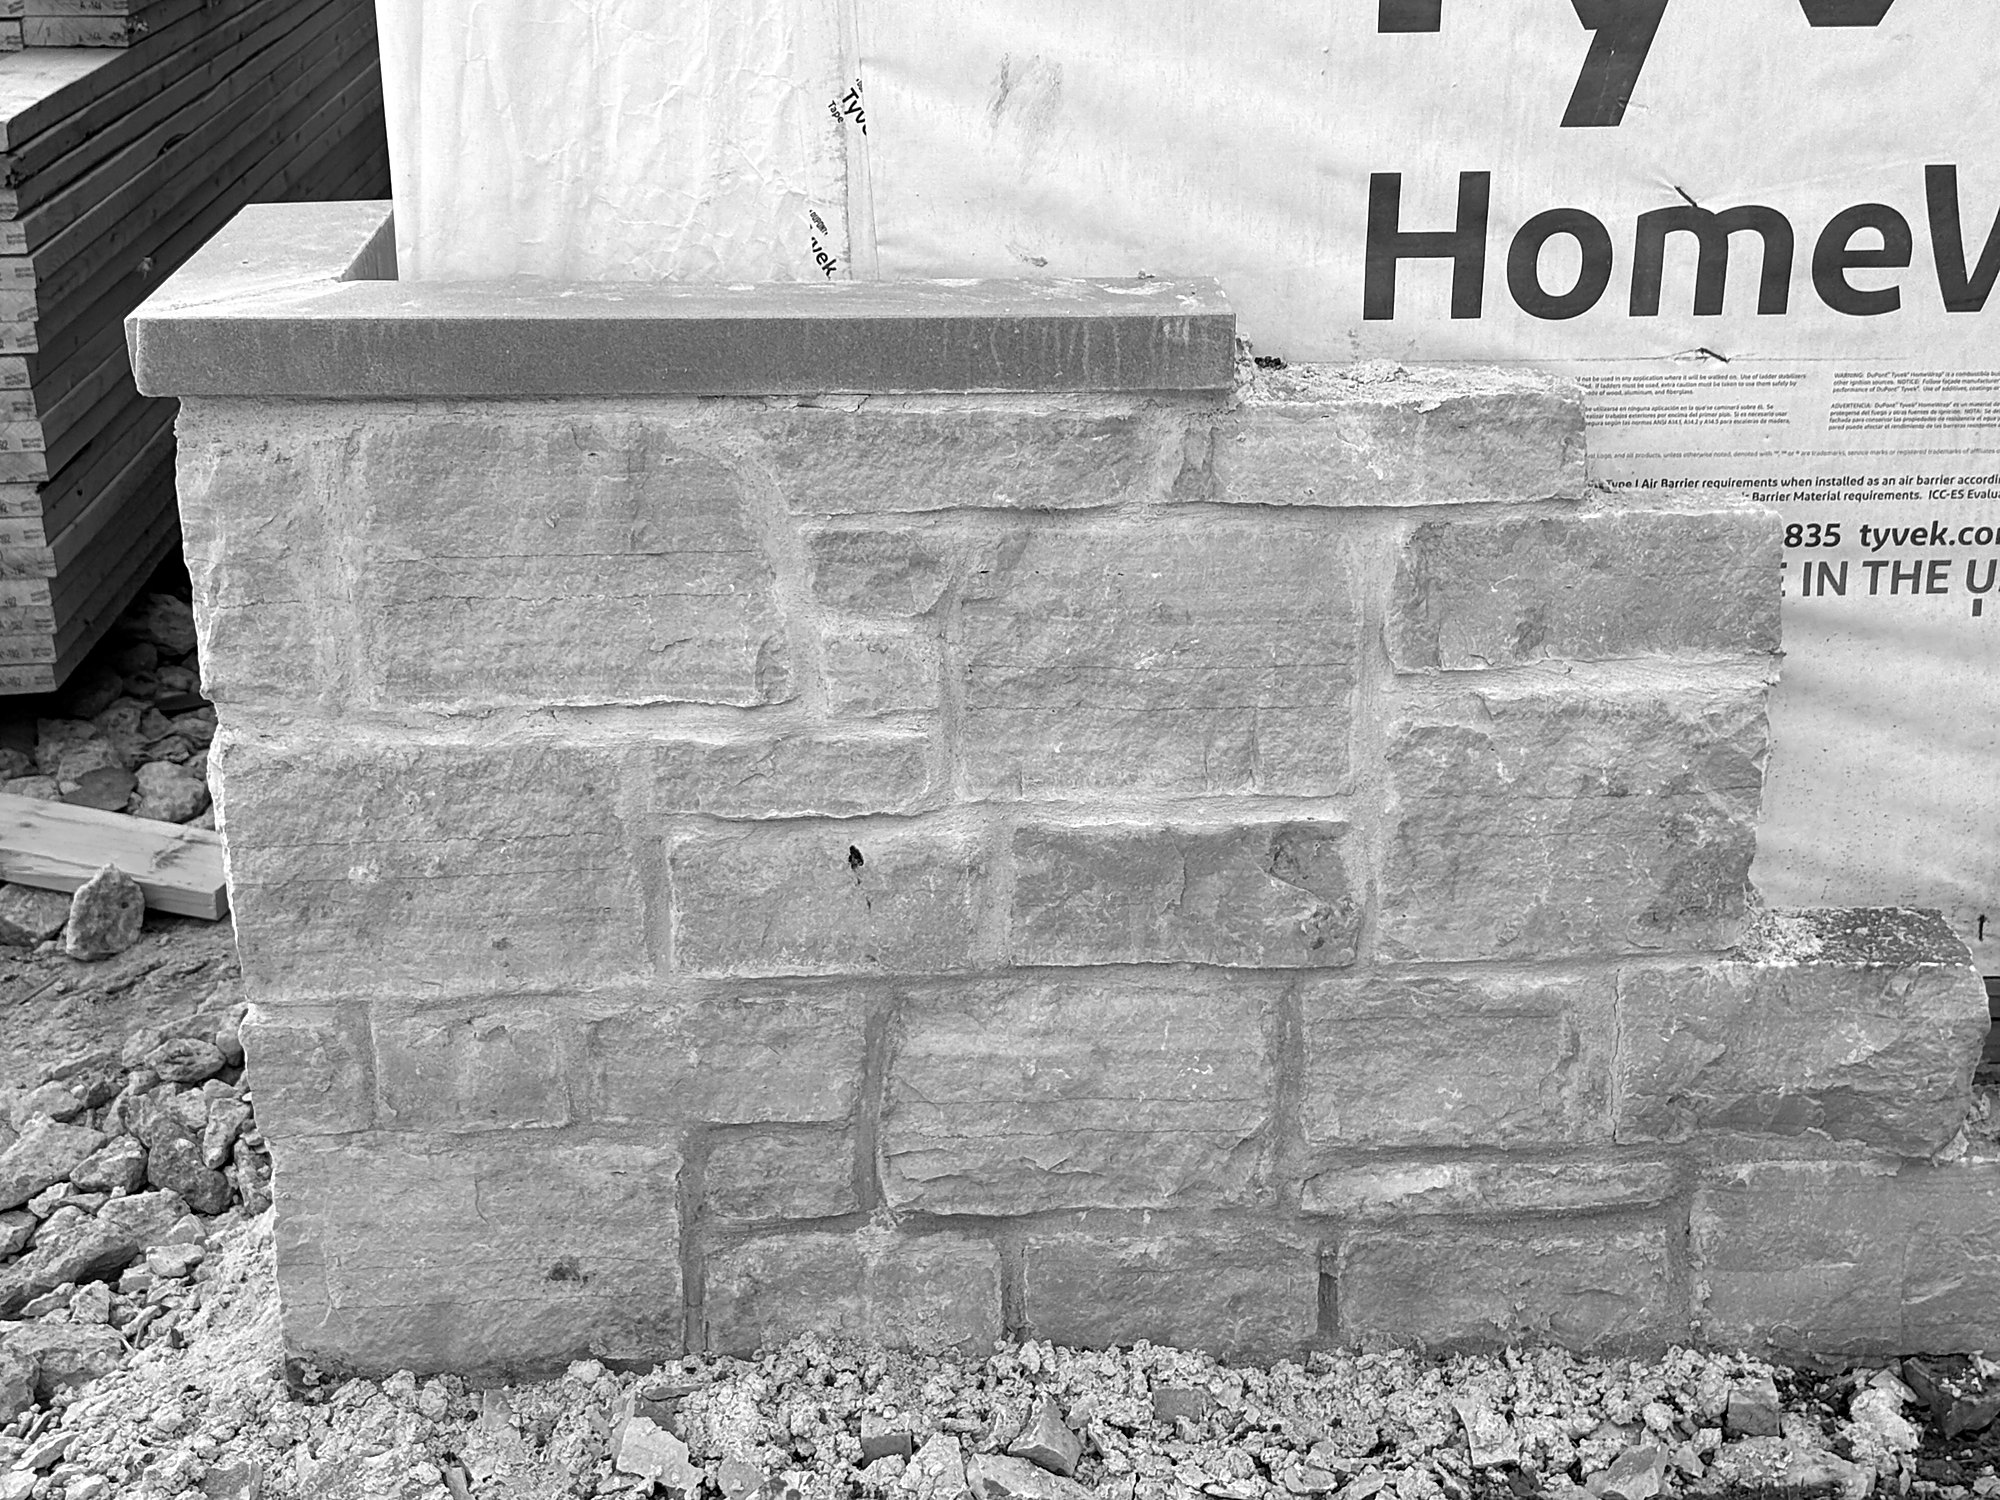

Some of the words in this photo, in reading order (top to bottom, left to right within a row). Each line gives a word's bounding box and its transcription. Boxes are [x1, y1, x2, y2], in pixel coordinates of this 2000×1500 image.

[828, 100, 844, 123] Tape
[810, 210, 828, 234] DUPONT
[810, 224, 837, 280] vek
[1641, 478, 1658, 488] Air
[1660, 478, 1699, 488] Barrier
[1702, 477, 1777, 490] requirements
[1780, 476, 1811, 487] when
[1815, 476, 1864, 486] installed
[1866, 478, 1879, 486] as
[1882, 477, 1895, 486] an
[1898, 475, 1914, 485] air
[1916, 474, 1955, 485] barrier
[1752, 491, 1790, 502] Barrier
[1793, 491, 1840, 501] Material
[1844, 490, 1922, 503] requirements.
[1929, 490, 1964, 500] ICC-ES
[1802, 561, 1848, 597] IN
[1862, 559, 1952, 596] THE
[1966, 559, 2000, 594] U
